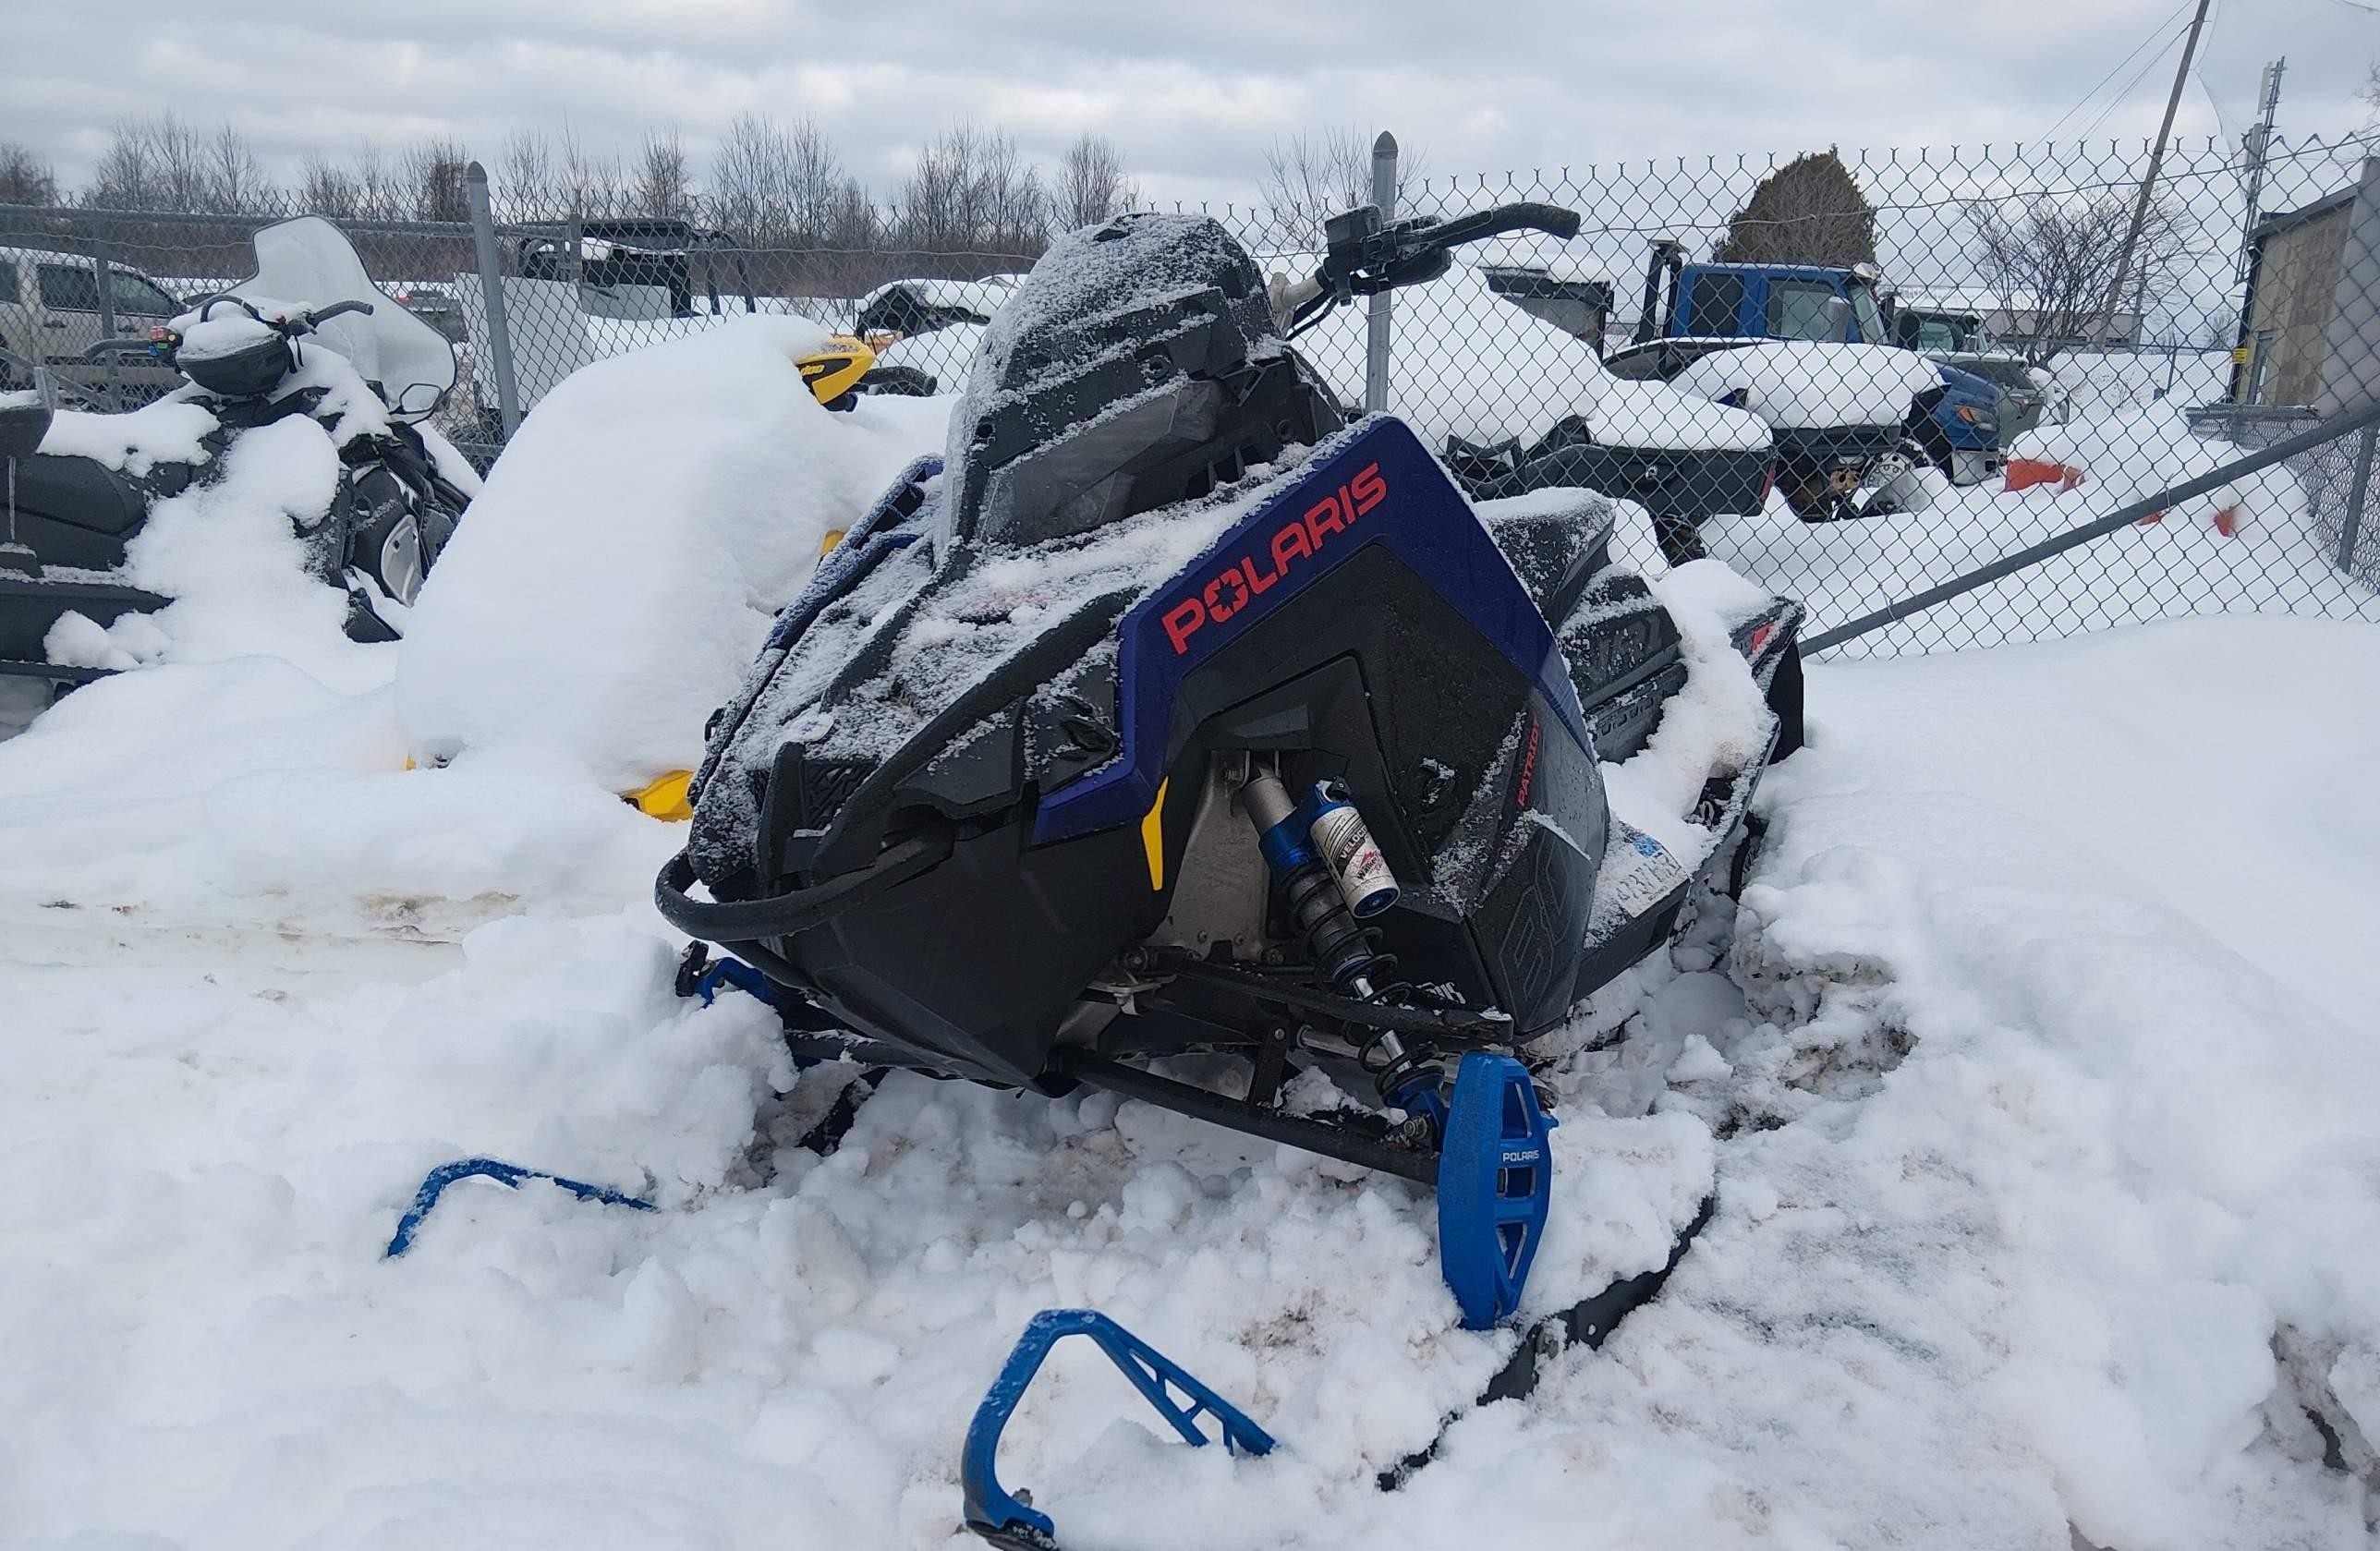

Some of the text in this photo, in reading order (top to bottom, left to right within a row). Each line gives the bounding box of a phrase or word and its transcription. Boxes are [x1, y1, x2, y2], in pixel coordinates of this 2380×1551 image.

[1161, 462, 1389, 655] POLARIS
[1518, 709, 1539, 806] PATRIOT
[1502, 1149, 1540, 1163] POLARIS
